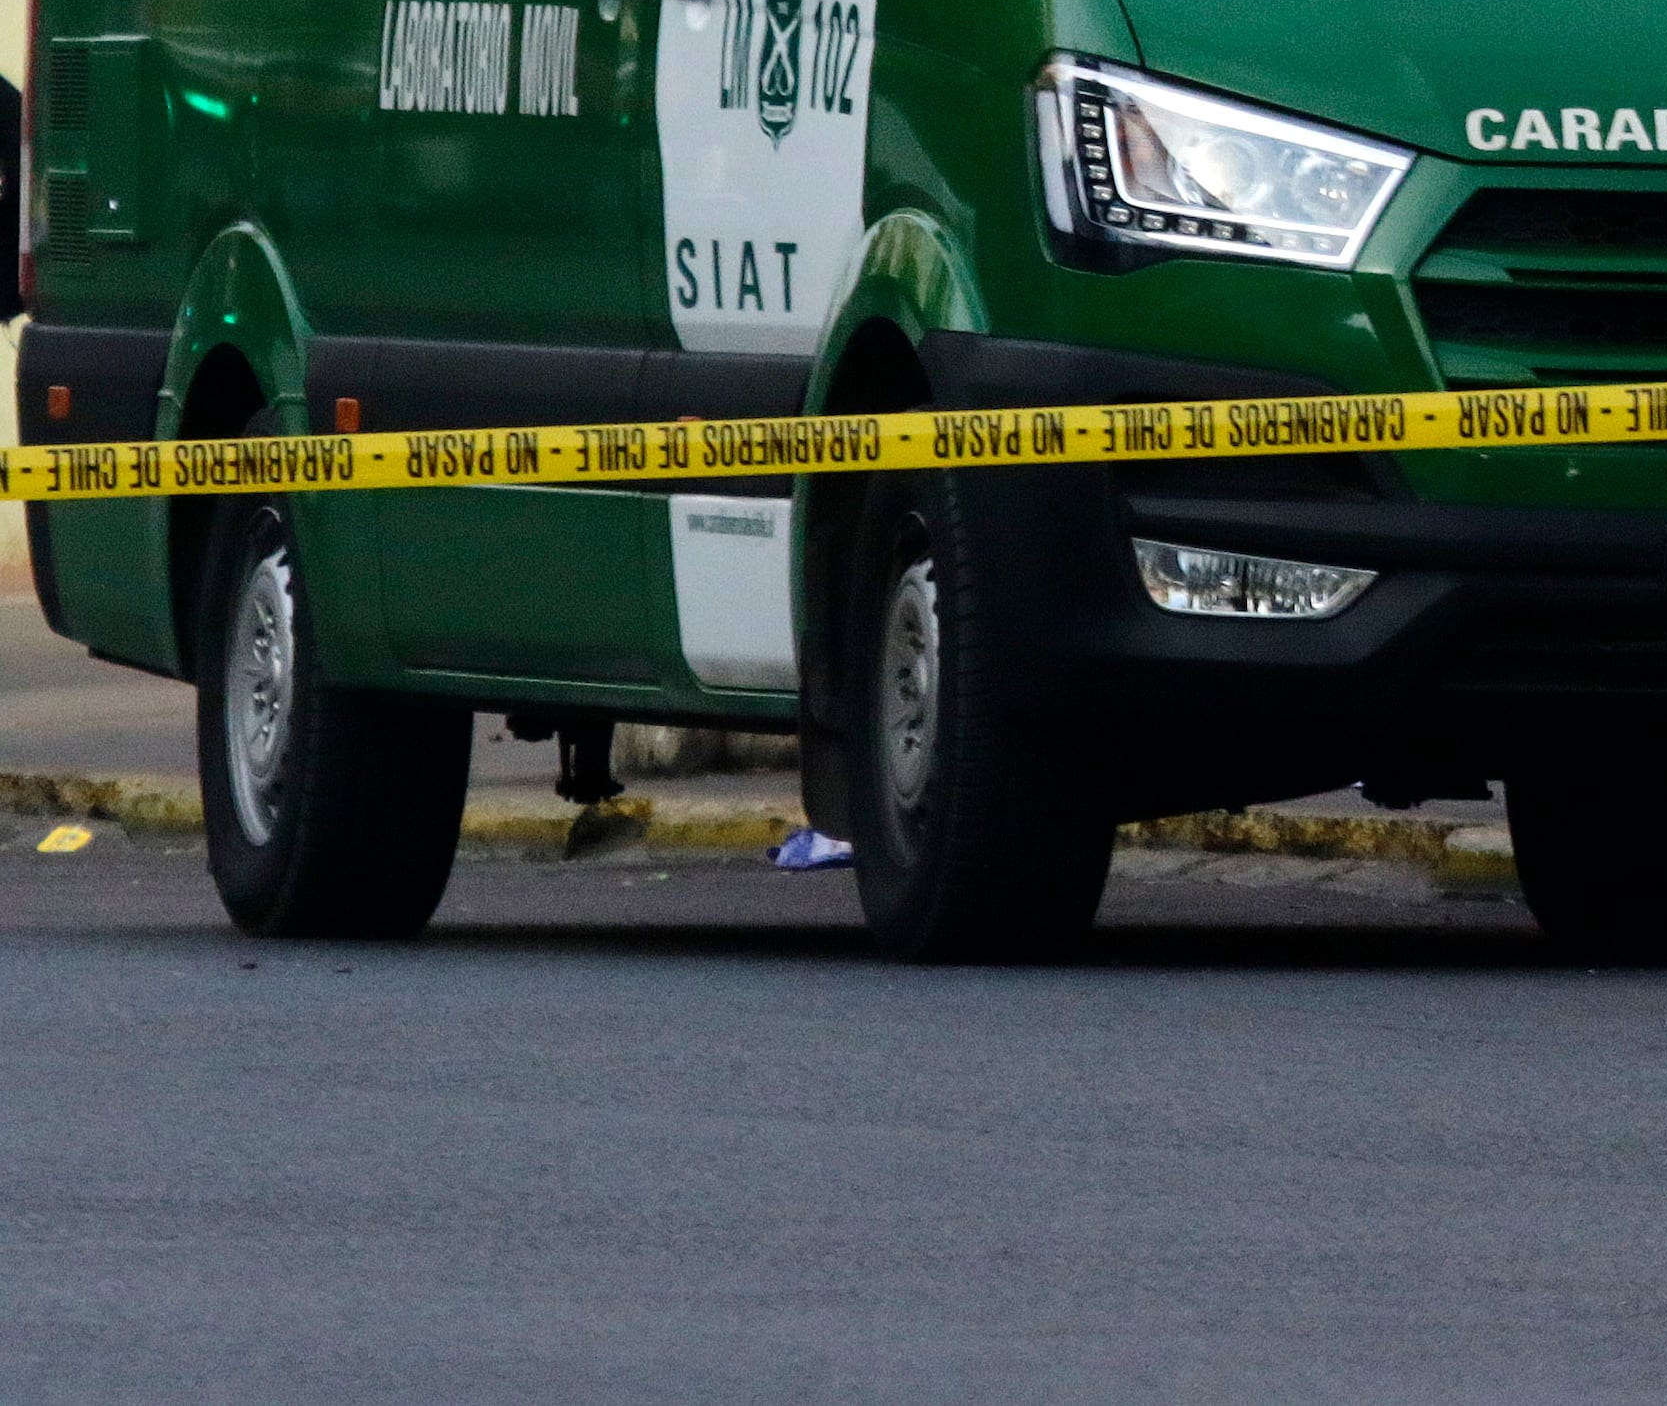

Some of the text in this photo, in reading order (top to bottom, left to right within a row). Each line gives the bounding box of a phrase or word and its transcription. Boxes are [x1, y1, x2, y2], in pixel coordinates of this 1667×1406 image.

[380, 0, 511, 115] LABORATORIO
[810, 0, 859, 115] 102
[676, 238, 798, 312] SIAT
[1032, 412, 1065, 455] NO
[1100, 407, 1172, 452] CHILE
[1184, 405, 1216, 449] DE
[1227, 398, 1406, 447] CARABINEROS
[1459, 393, 1545, 438] PASAR
[1557, 392, 1589, 434] NO
[405, 432, 495, 478] PASAR
[507, 431, 540, 475] NO
[576, 428, 647, 472] CHILE
[658, 426, 690, 469] DE
[702, 418, 880, 467] CARABINEROS
[933, 413, 1020, 459] PASAR
[46, 447, 116, 492] CHILE
[128, 444, 162, 489] DE
[174, 438, 354, 487] CARABINEROS
